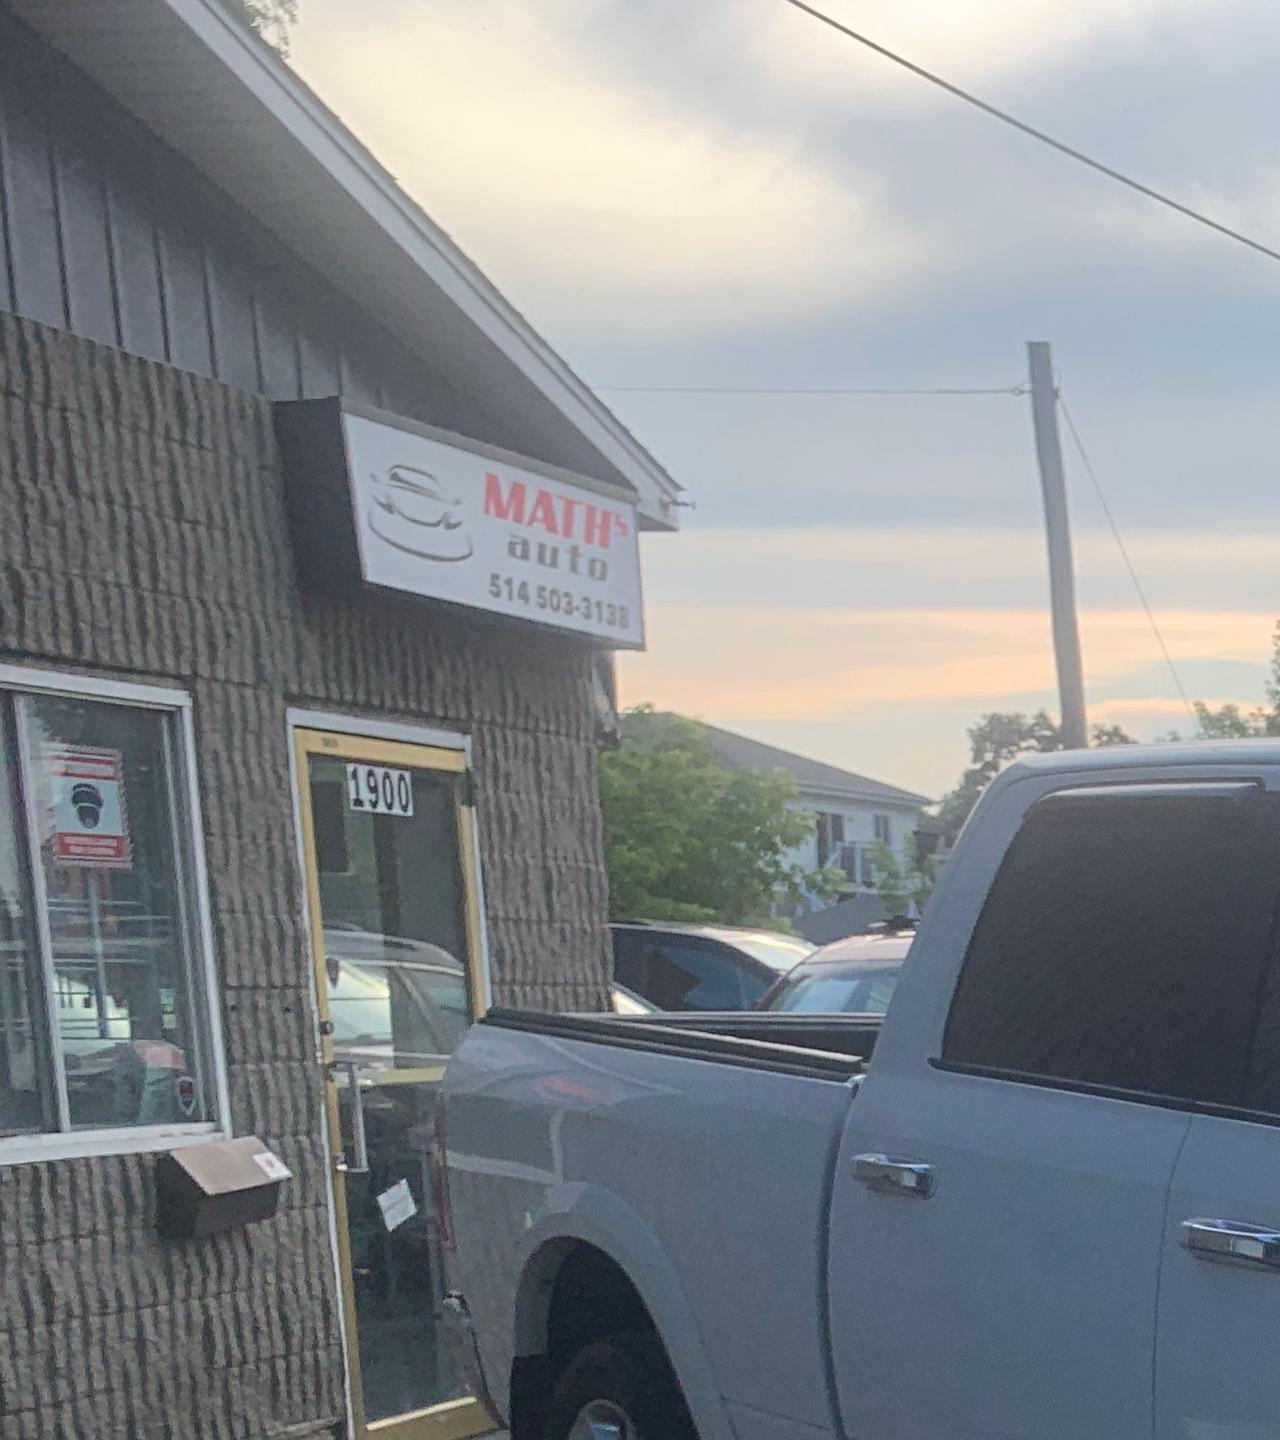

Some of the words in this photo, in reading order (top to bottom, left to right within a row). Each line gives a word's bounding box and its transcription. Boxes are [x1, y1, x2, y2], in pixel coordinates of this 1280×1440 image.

[507, 534, 609, 582] auto
[489, 573, 530, 604] 514
[351, 766, 409, 812] 1900
